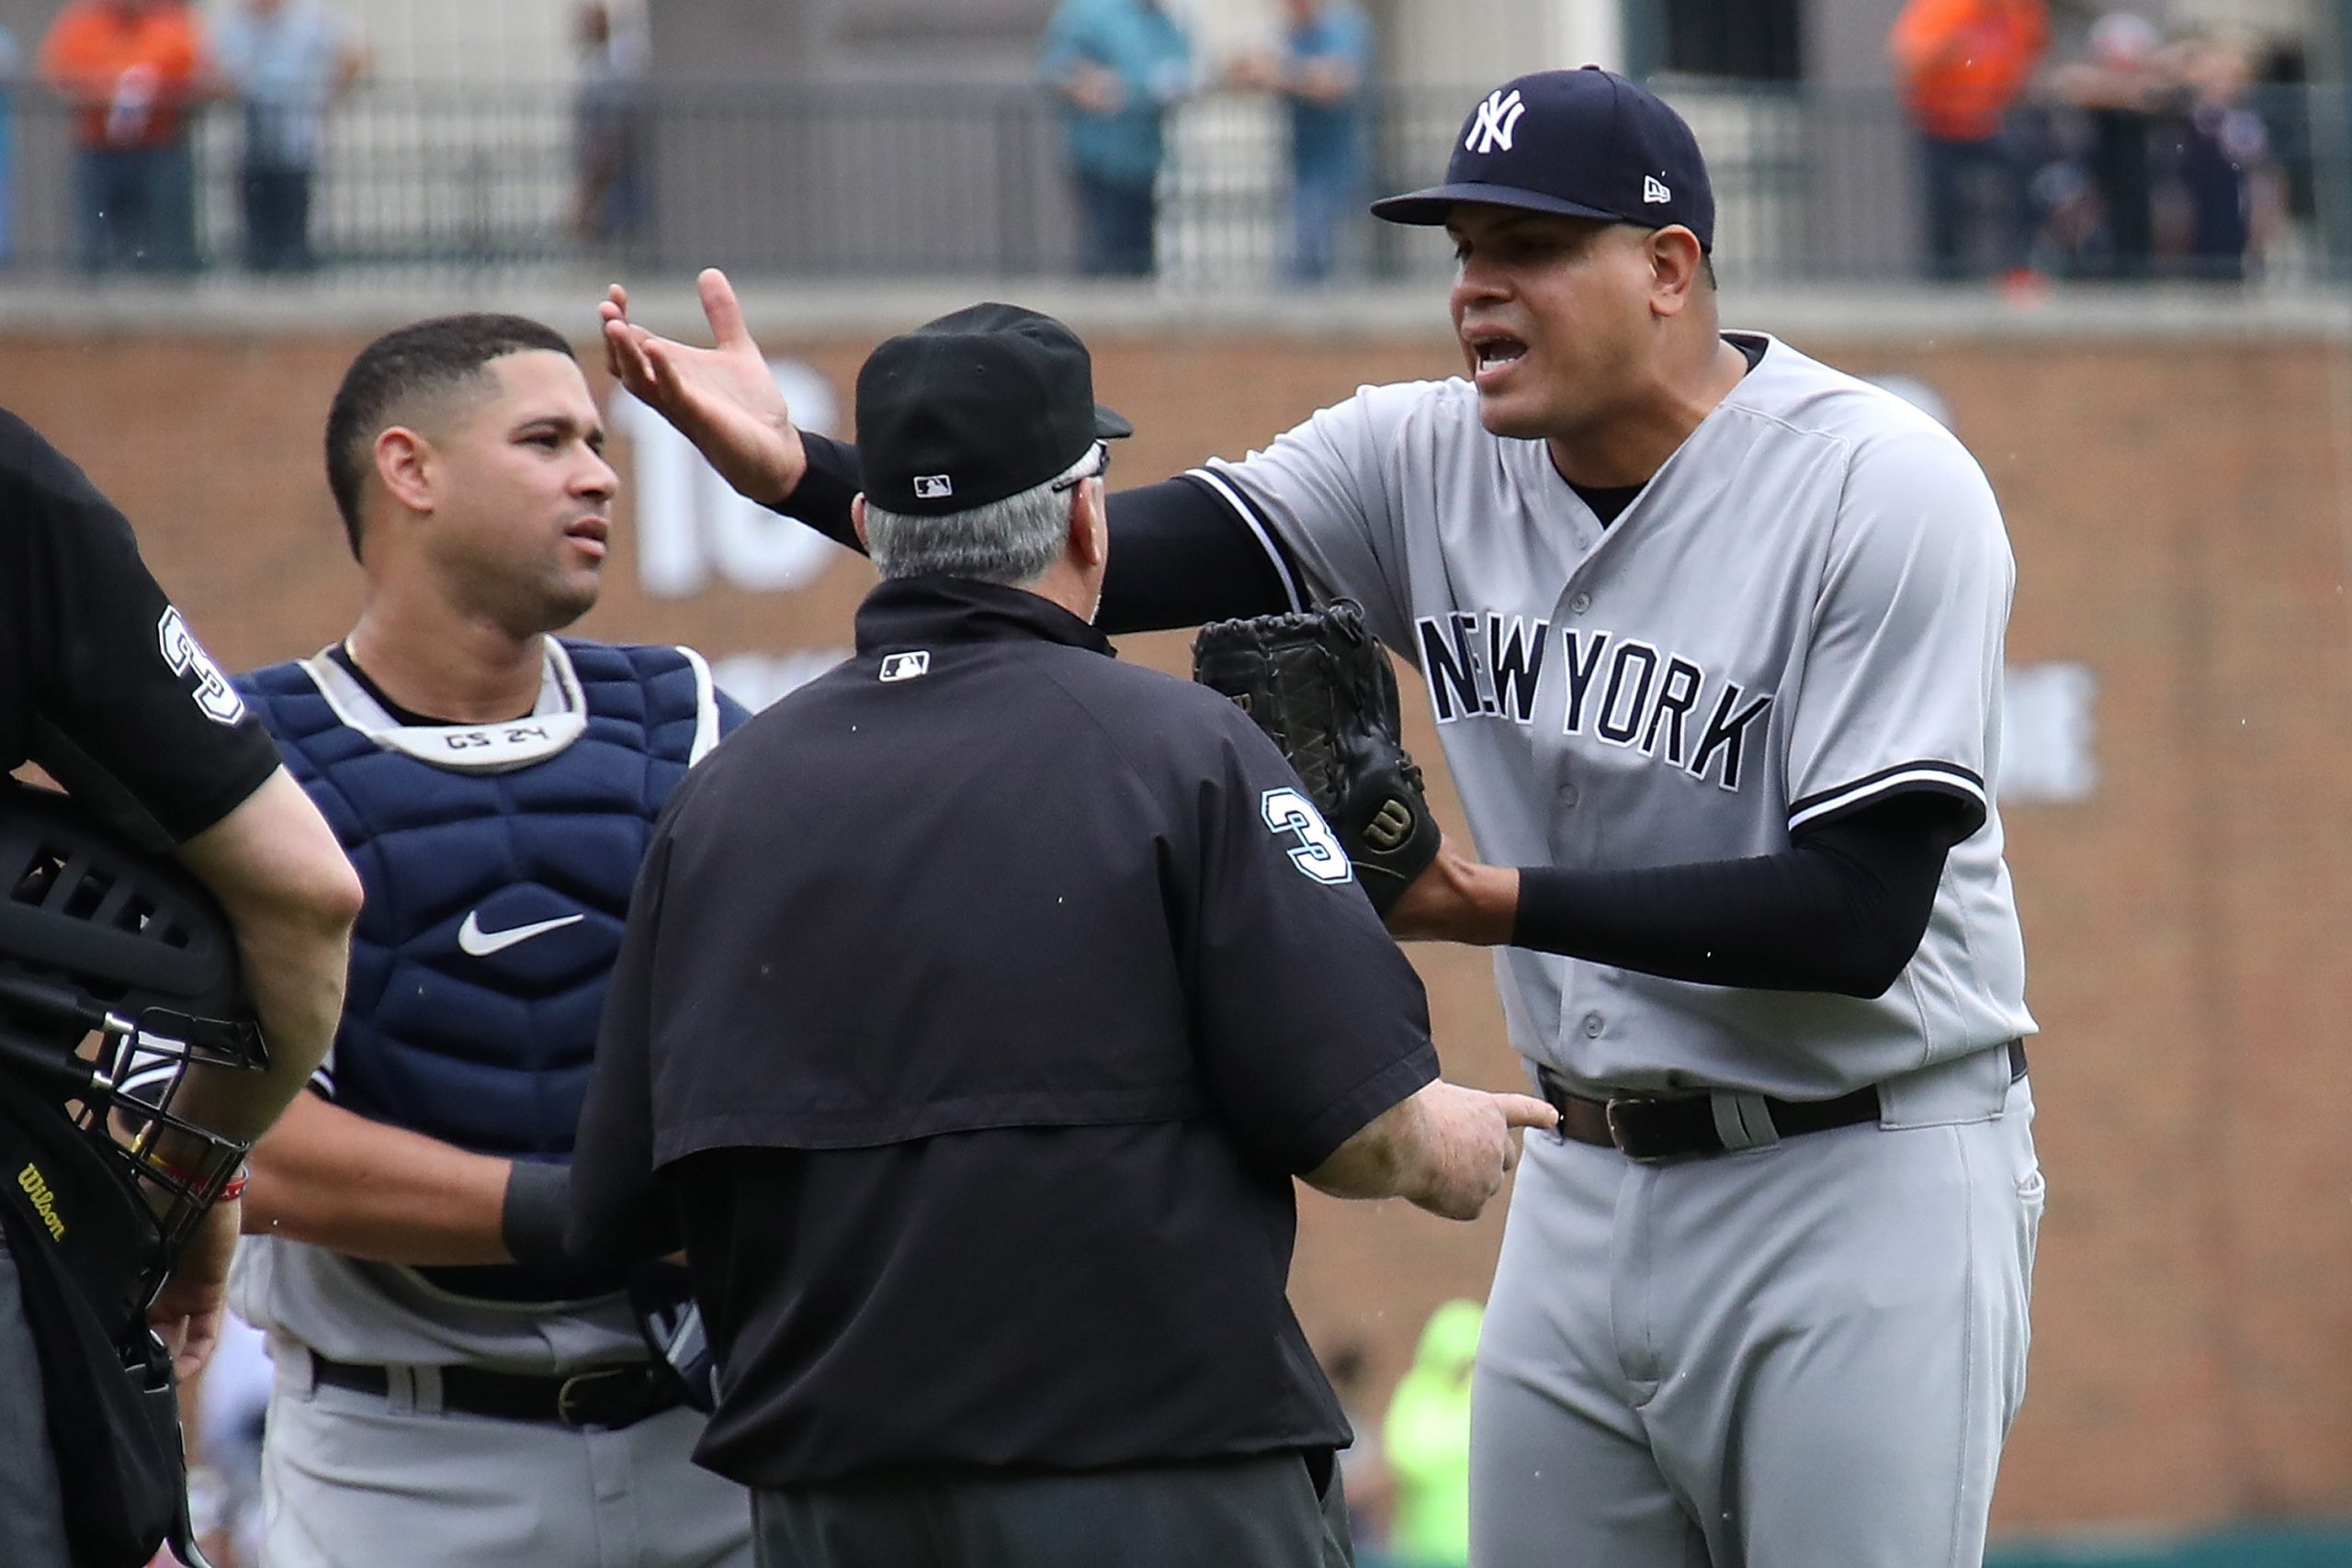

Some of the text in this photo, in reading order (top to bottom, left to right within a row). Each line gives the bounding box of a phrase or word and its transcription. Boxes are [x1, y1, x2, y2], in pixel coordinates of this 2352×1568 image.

[1464, 89, 1526, 153] NY
[157, 604, 245, 725] 3
[1562, 628, 1775, 794] YORK
[1261, 786, 1353, 885] 3
[17, 1162, 65, 1242] Wilson
